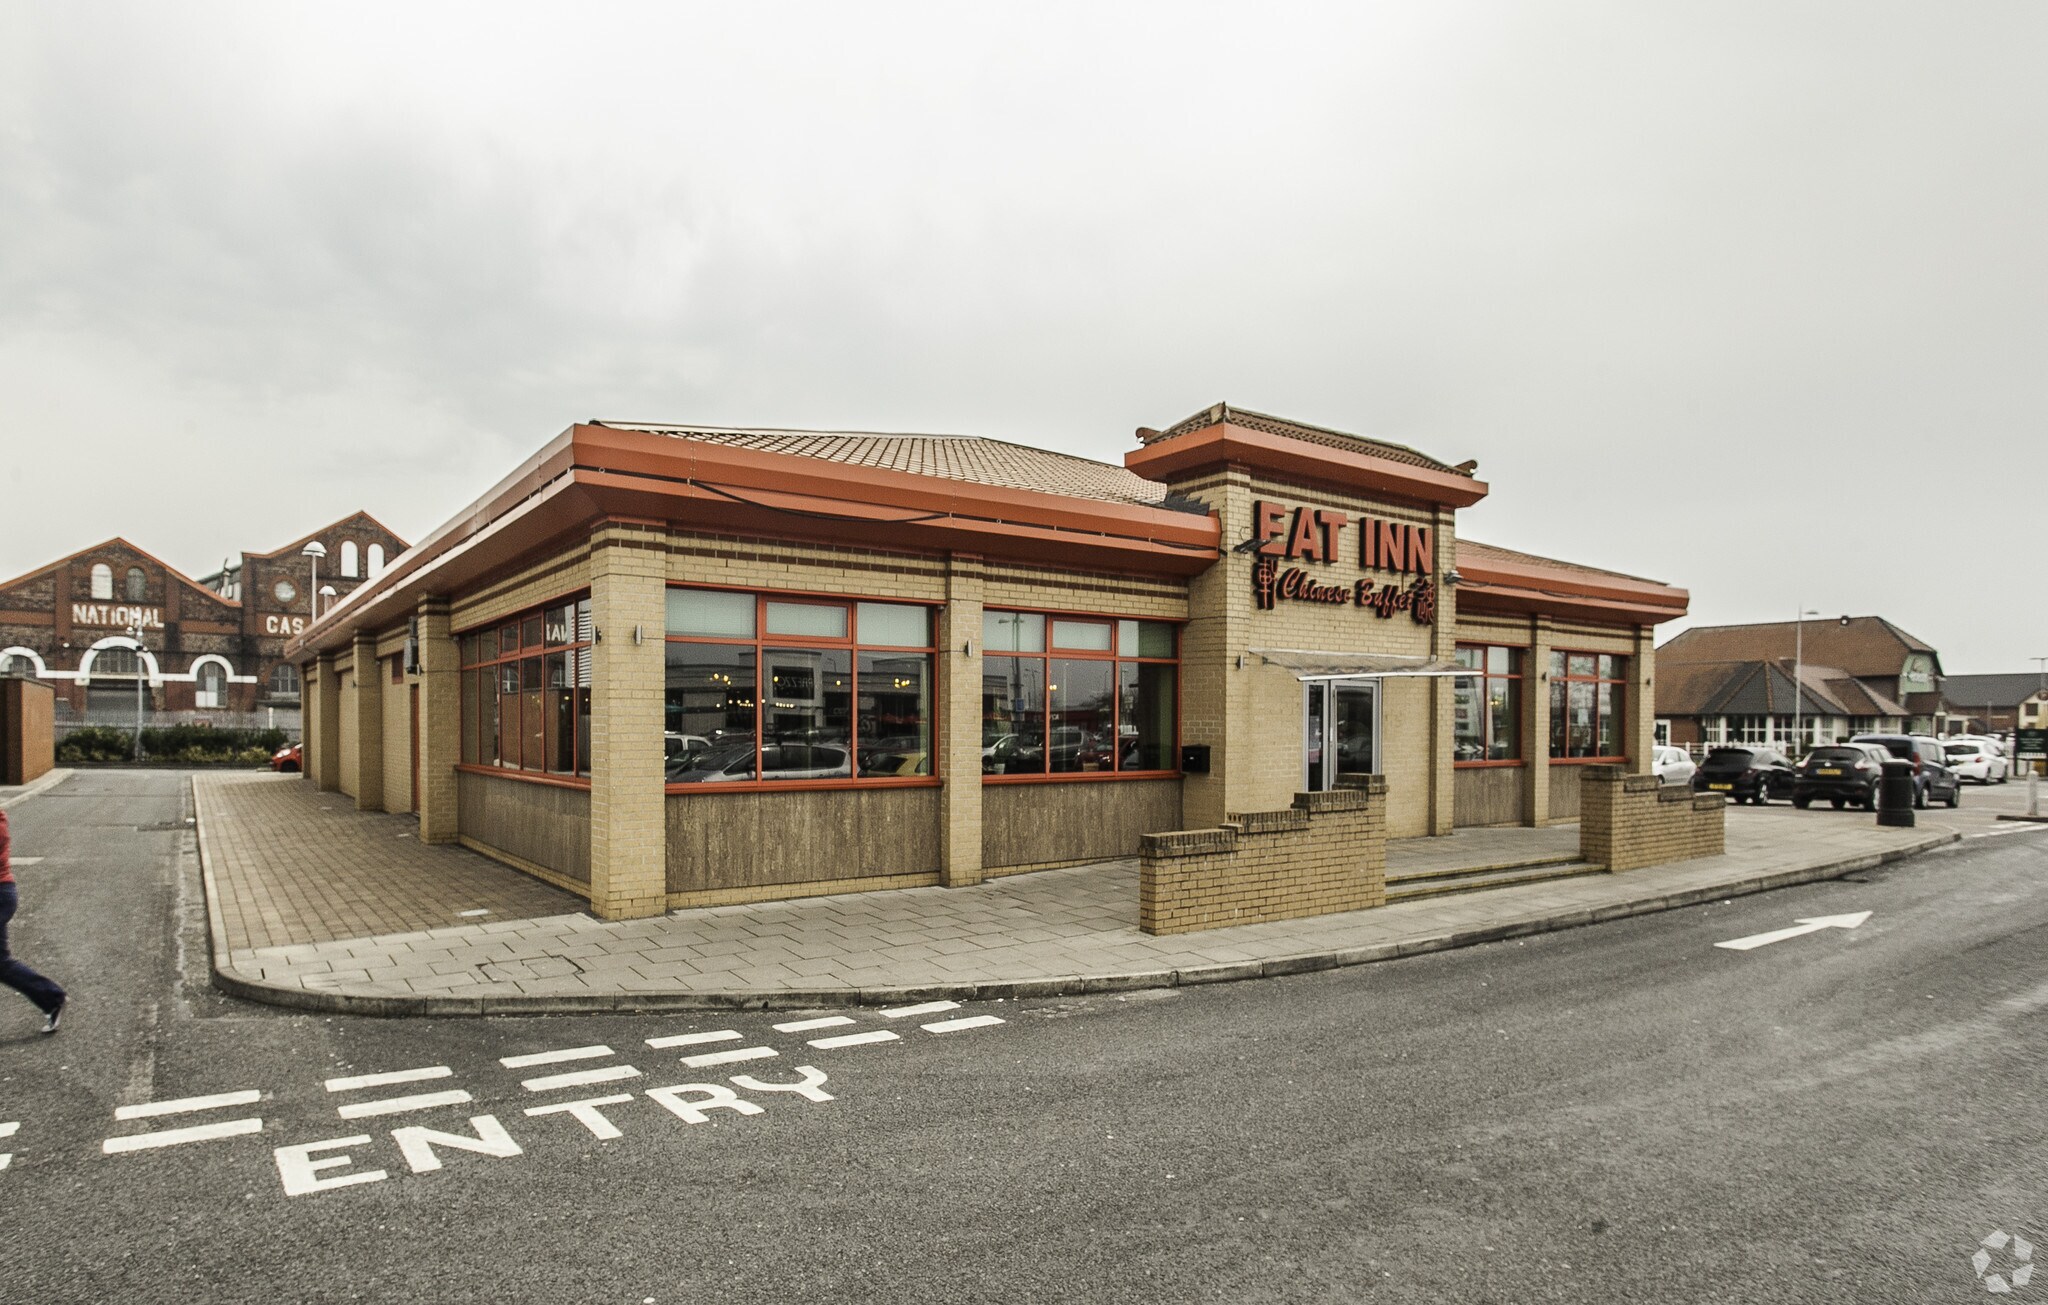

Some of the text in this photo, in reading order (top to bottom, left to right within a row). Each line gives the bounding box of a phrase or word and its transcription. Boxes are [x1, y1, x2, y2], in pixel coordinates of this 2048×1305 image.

[1256, 500, 1434, 576] EAT INN
[72, 603, 165, 629] NATIONAL
[1279, 566, 1352, 604] Chinese
[1354, 577, 1415, 618] Buffet
[273, 1065, 835, 1197] ENTRY
